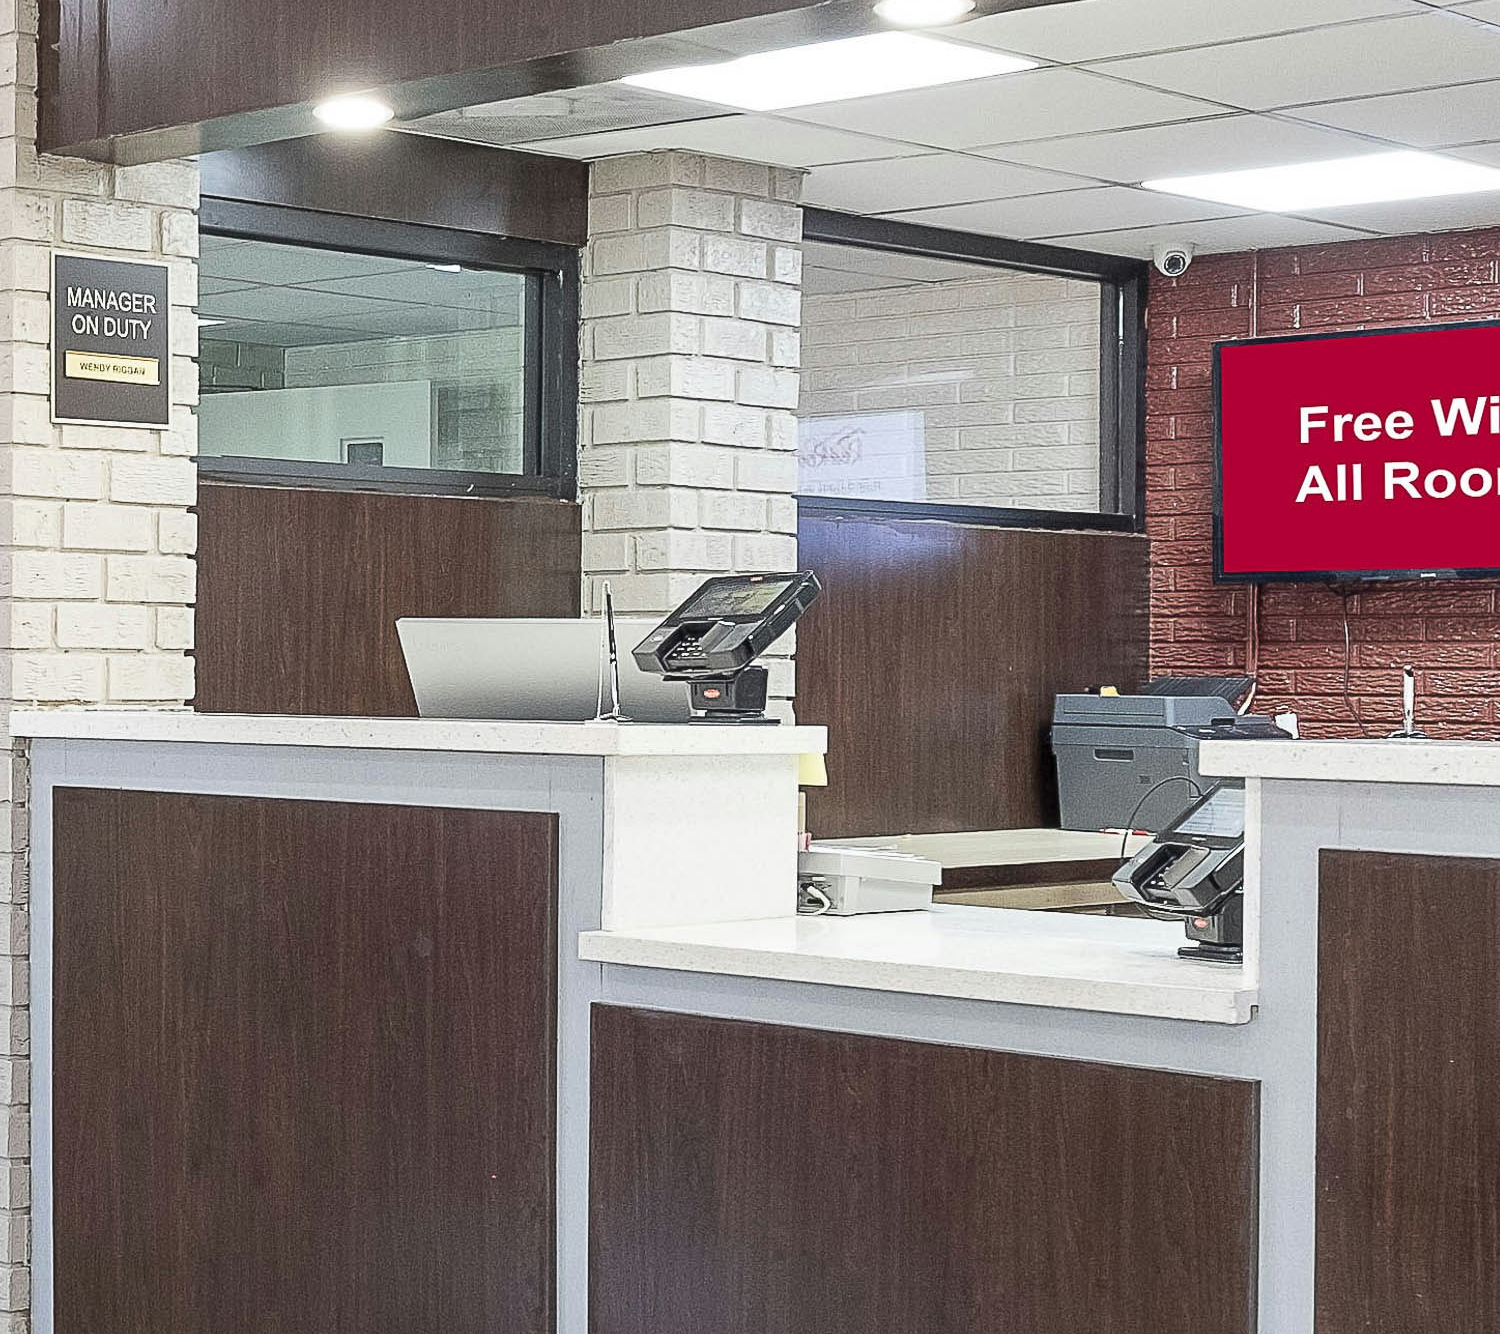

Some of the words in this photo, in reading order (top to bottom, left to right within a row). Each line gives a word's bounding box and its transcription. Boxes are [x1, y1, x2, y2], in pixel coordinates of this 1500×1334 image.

[67, 286, 157, 314] MANAGER
[71, 314, 99, 336] ON
[103, 317, 151, 340] DUTY
[1299, 405, 1414, 444] Free
[1295, 463, 1363, 503] All
